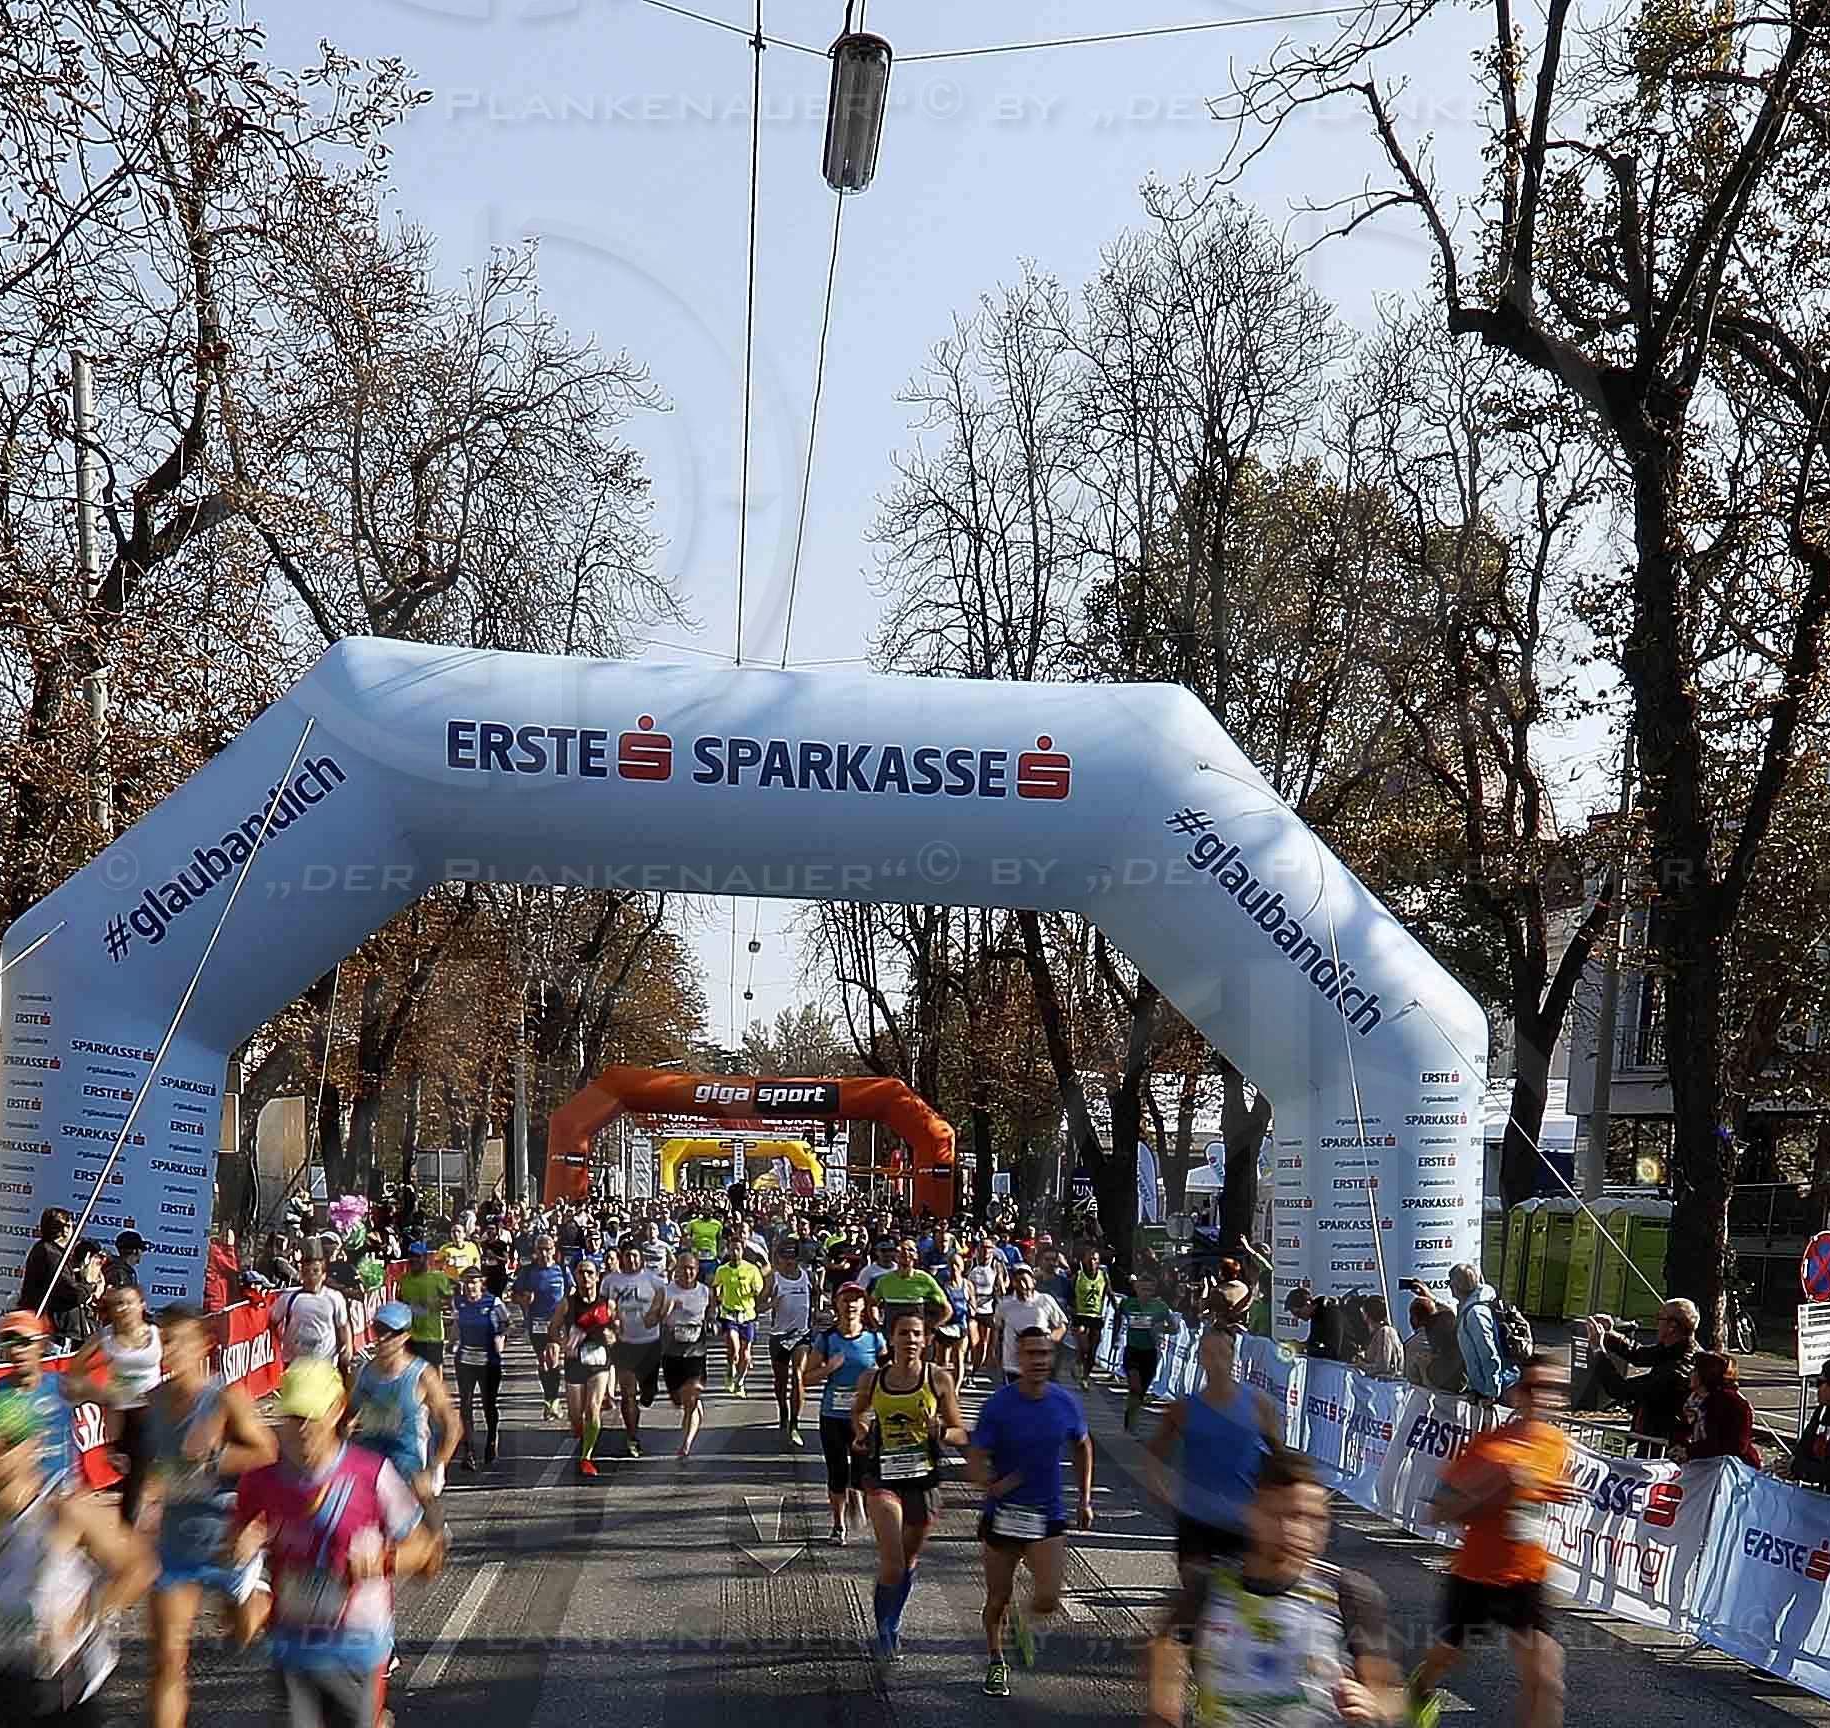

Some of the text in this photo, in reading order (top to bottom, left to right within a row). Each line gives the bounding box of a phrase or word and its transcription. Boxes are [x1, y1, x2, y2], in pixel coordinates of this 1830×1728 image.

[447, 719, 609, 778] ERSTE
[692, 735, 1009, 798] SPARKASSE
[104, 755, 347, 963] #glaubandich
[1166, 807, 1383, 1037] #glaubandich
[71, 1039, 142, 1061] SPARKASSE
[1422, 1072, 1450, 1084] ERSTE
[83, 1085, 120, 1100] ERSTE
[160, 1076, 211, 1096] SPARKASSE
[694, 1083, 826, 1106] giga sport
[1404, 1114, 1459, 1126] SPARKASSE
[170, 1121, 197, 1135] ERSTE
[1321, 1136, 1385, 1149] SPARKASSE
[150, 1159, 202, 1177] SPARKASSE
[1418, 1157, 1447, 1168] ERSTE
[1333, 1178, 1365, 1190] ERSTE
[160, 1202, 188, 1216] ERSTE
[1401, 1198, 1457, 1209] SPARKASSE
[1414, 1239, 1444, 1250] ERSTE
[1331, 1260, 1364, 1272] ERSTE
[151, 1284, 179, 1297] ERSTE
[1743, 1527, 1804, 1572] ERSTE
